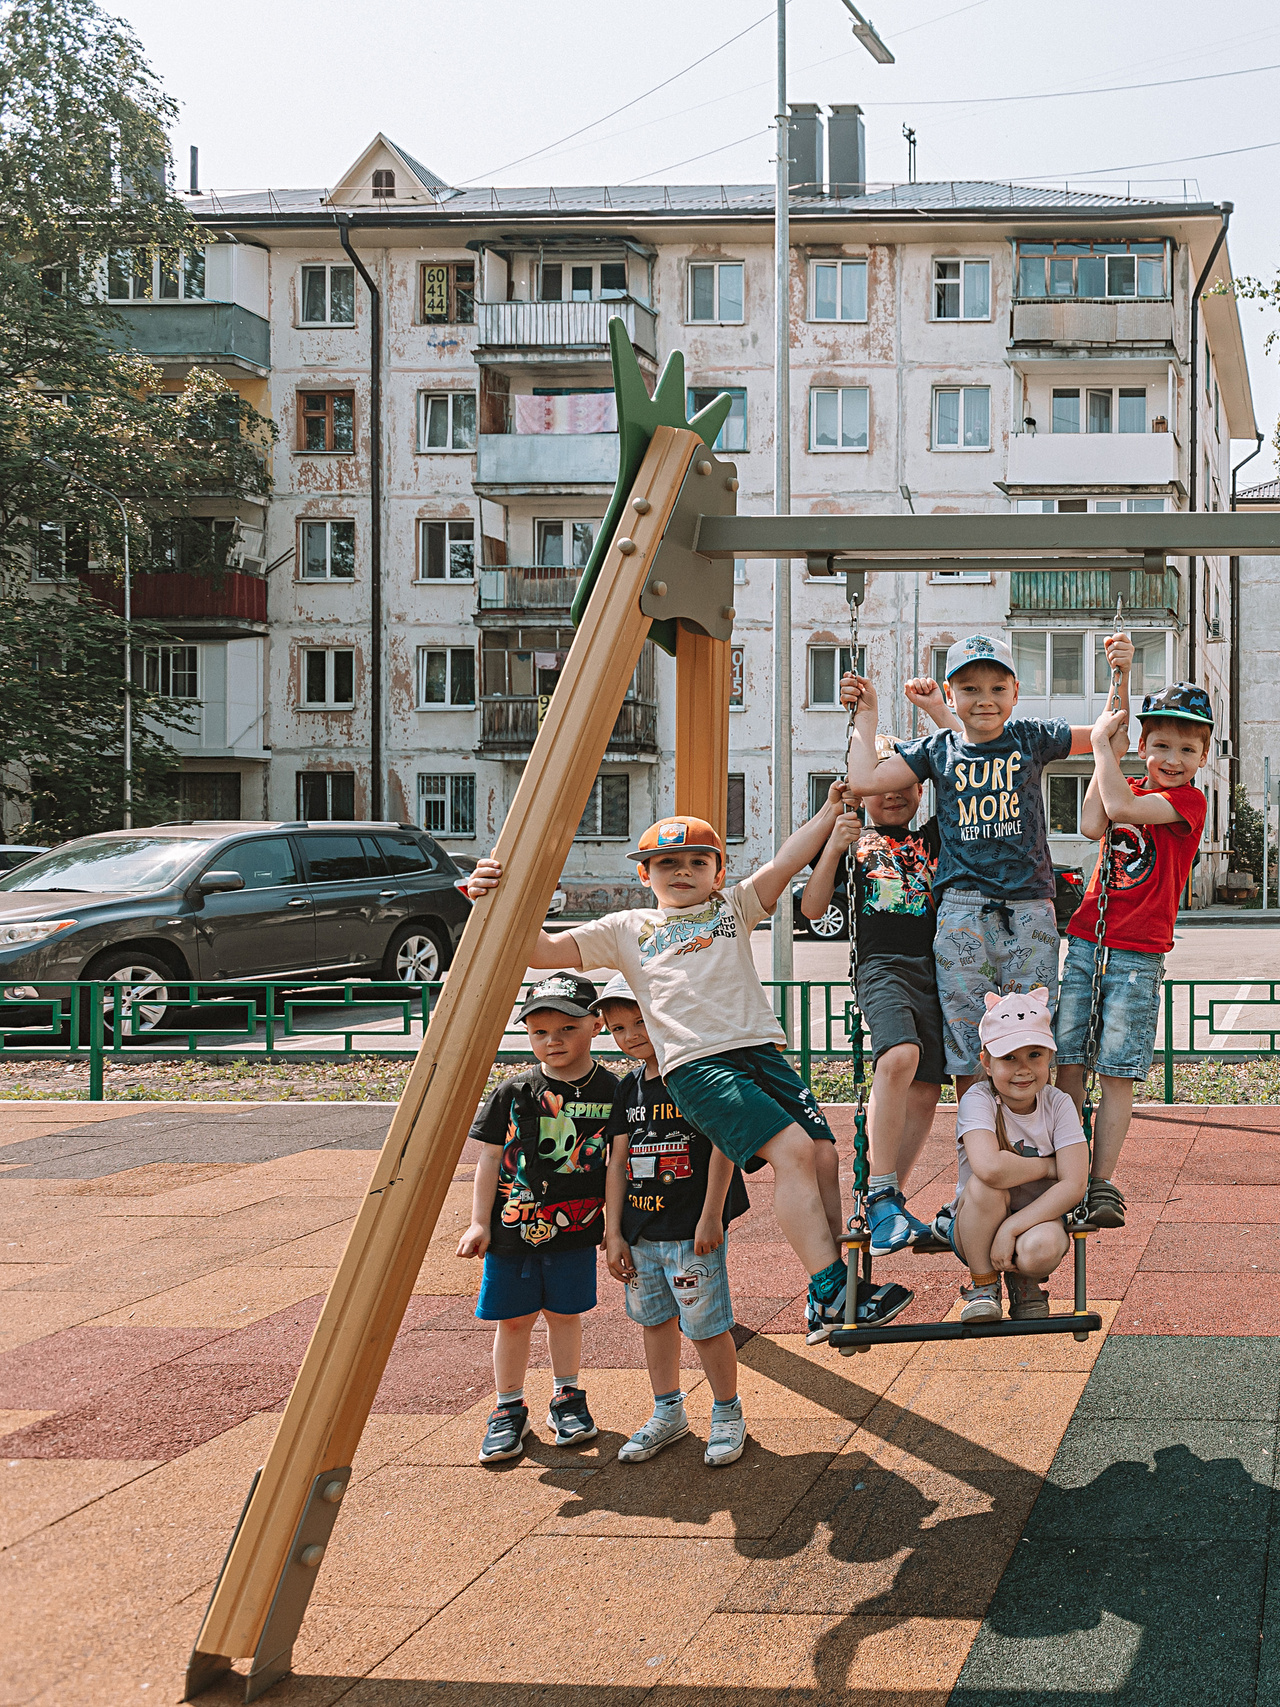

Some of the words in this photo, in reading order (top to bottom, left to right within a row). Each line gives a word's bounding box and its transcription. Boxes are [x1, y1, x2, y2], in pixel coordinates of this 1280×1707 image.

[427, 268, 445, 283] 60
[427, 283, 444, 298] 41
[427, 298, 445, 312] 44
[955, 751, 1021, 792] SURF
[960, 825, 980, 841] KEEP
[983, 823, 992, 839] IT
[993, 820, 1022, 838] SIMPLE
[711, 929, 738, 939] RIDE
[564, 1101, 614, 1120] SPIKE
